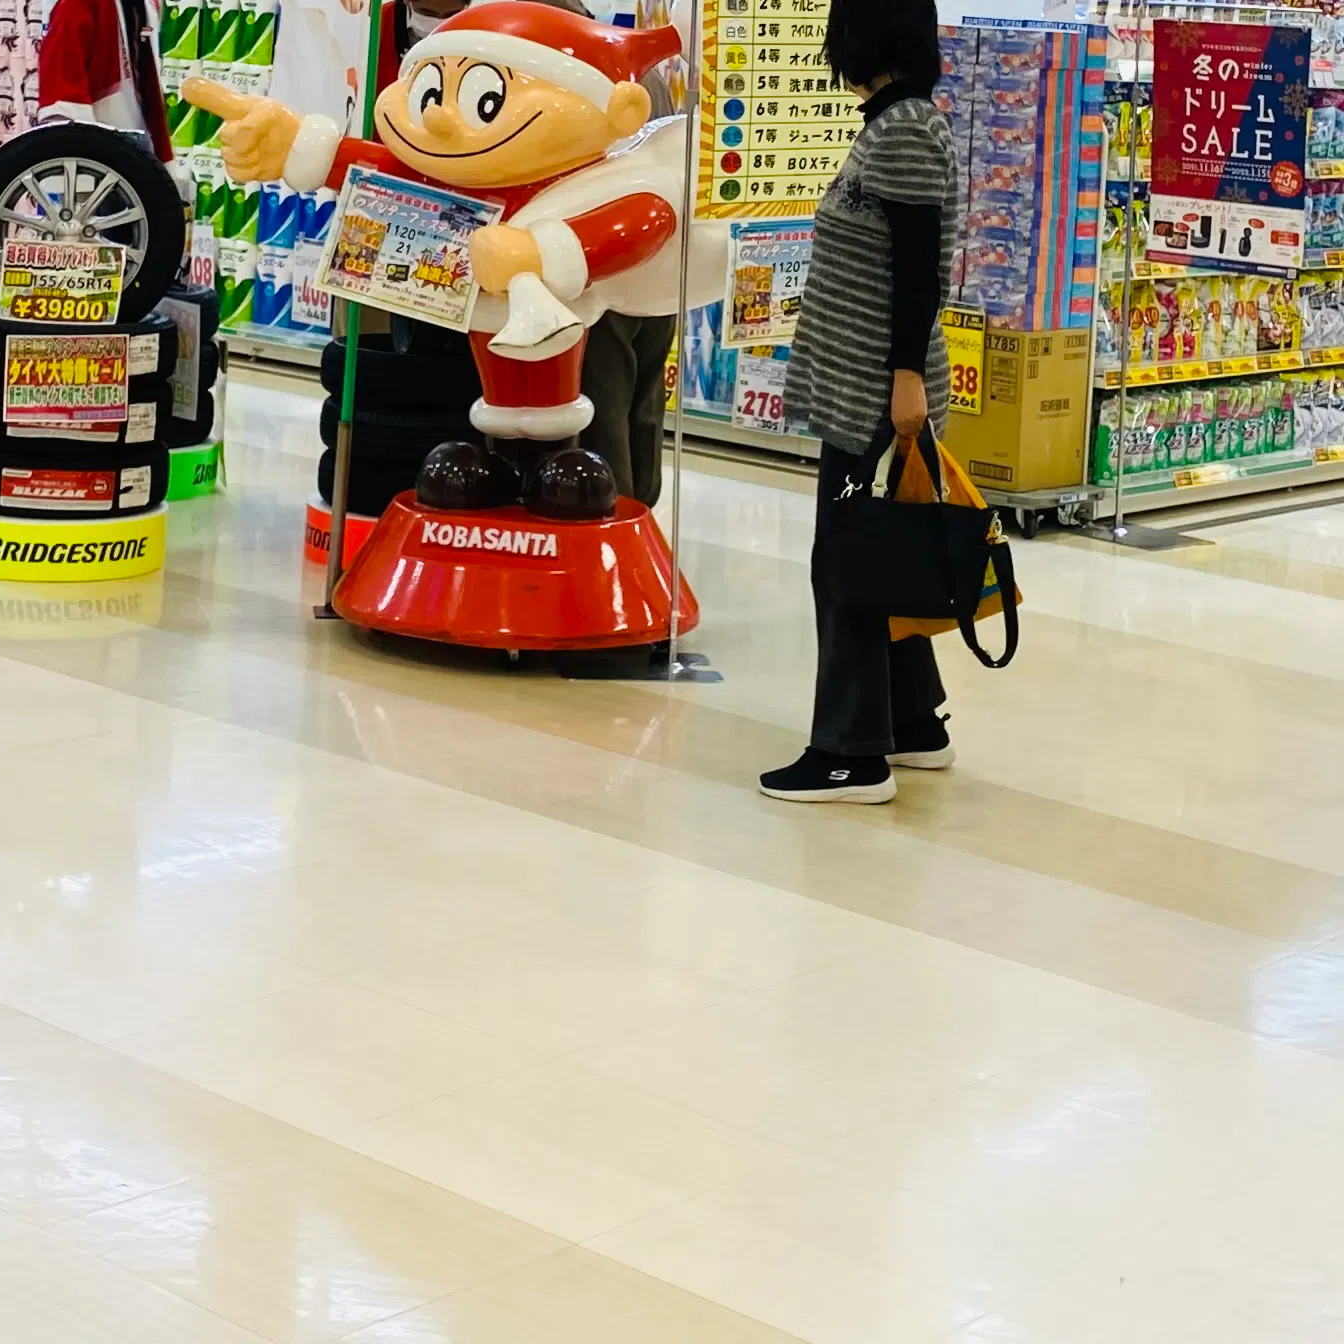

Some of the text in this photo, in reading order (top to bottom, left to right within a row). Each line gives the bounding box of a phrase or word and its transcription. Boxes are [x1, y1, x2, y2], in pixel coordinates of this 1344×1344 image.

[726, 23, 780, 38] 白色 3等
[758, 49, 780, 63] 4等
[1192, 54, 1239, 81] 冬の
[757, 76, 780, 90] 5等
[756, 102, 778, 116] 6等
[1184, 87, 1275, 123] ドリーム
[755, 129, 777, 143] 7等
[1181, 124, 1273, 161] SALE
[754, 155, 775, 168] 8等
[750, 181, 774, 195] 9等
[32, 274, 113, 290] 155/65R14
[14, 299, 104, 321] ¥39800
[986, 336, 1017, 352] 1785
[743, 390, 784, 420] 278
[11, 485, 88, 498] BLIZZAK
[421, 521, 558, 556] KOBASANTA
